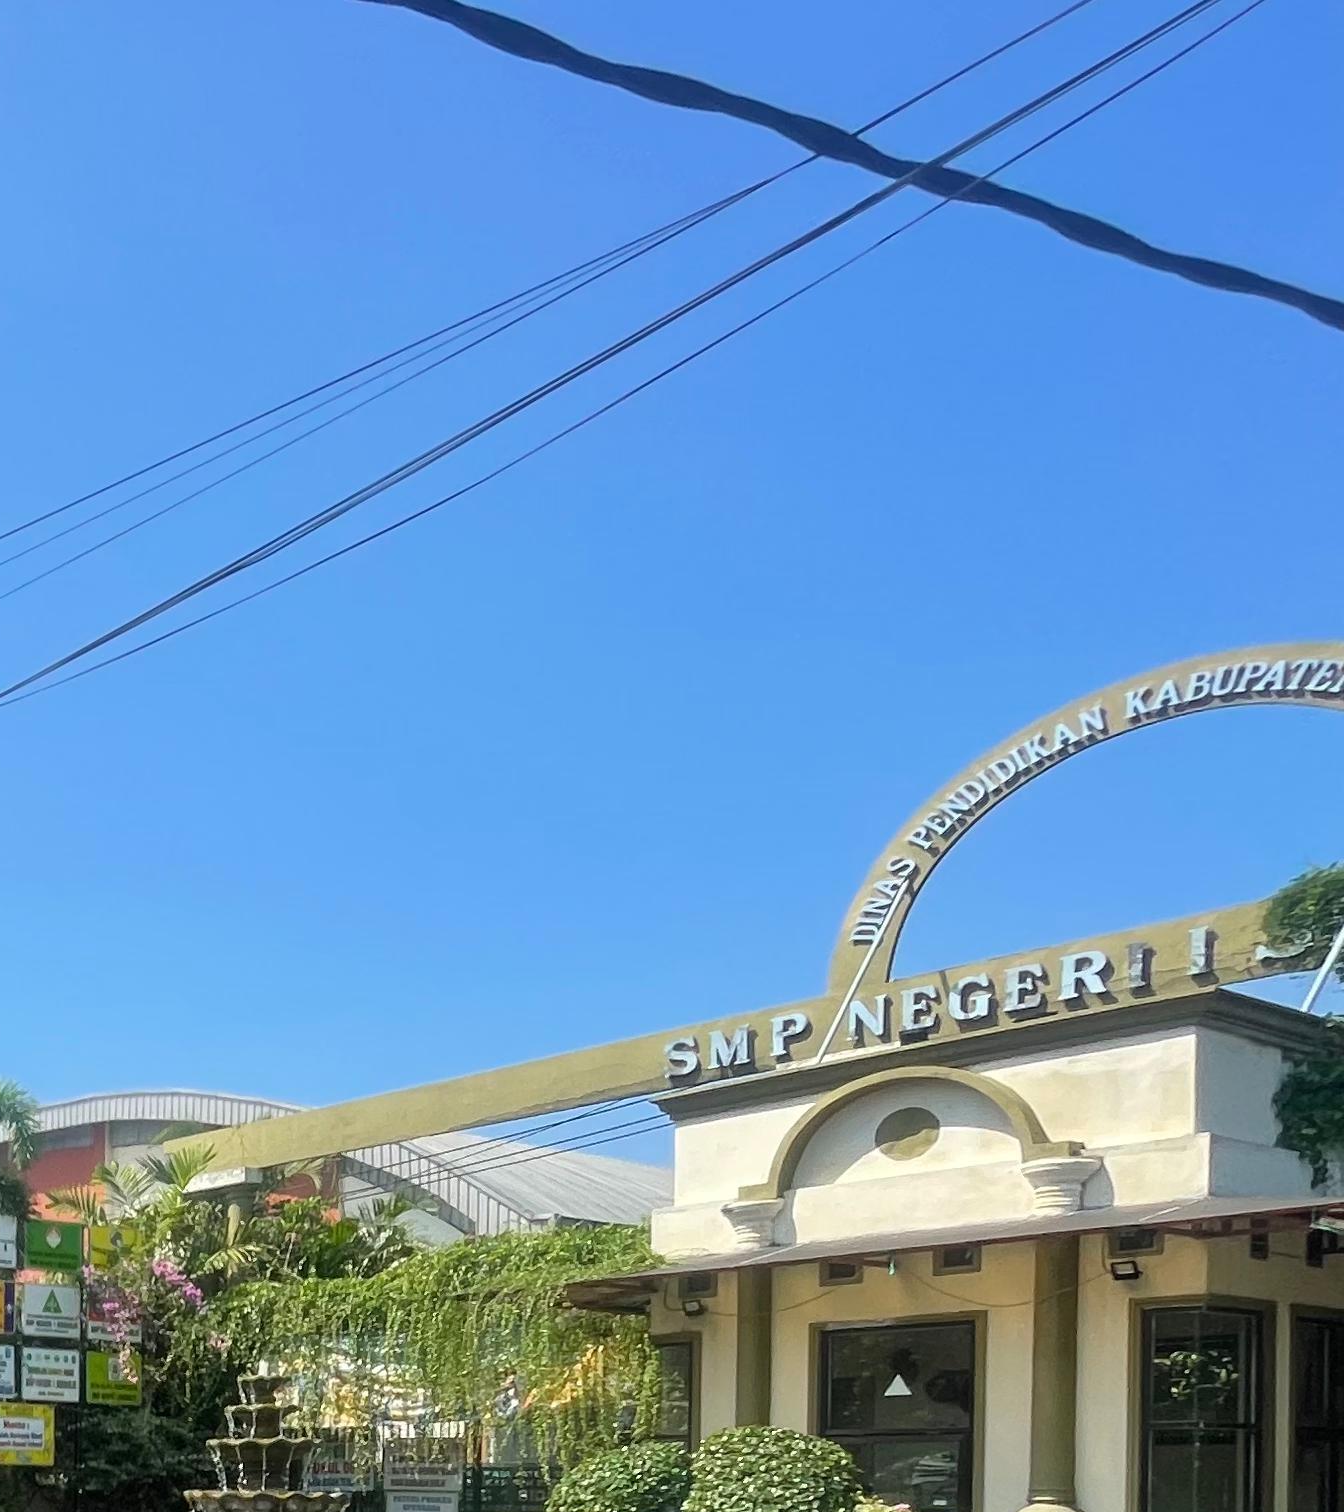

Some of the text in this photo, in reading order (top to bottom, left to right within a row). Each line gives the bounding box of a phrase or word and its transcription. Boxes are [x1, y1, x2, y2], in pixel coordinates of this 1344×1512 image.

[850, 855, 917, 946] DINAS
[905, 701, 1110, 851] PENDIDIKAN
[664, 1011, 810, 1079] SMP
[845, 942, 1152, 1042] NEGERI
